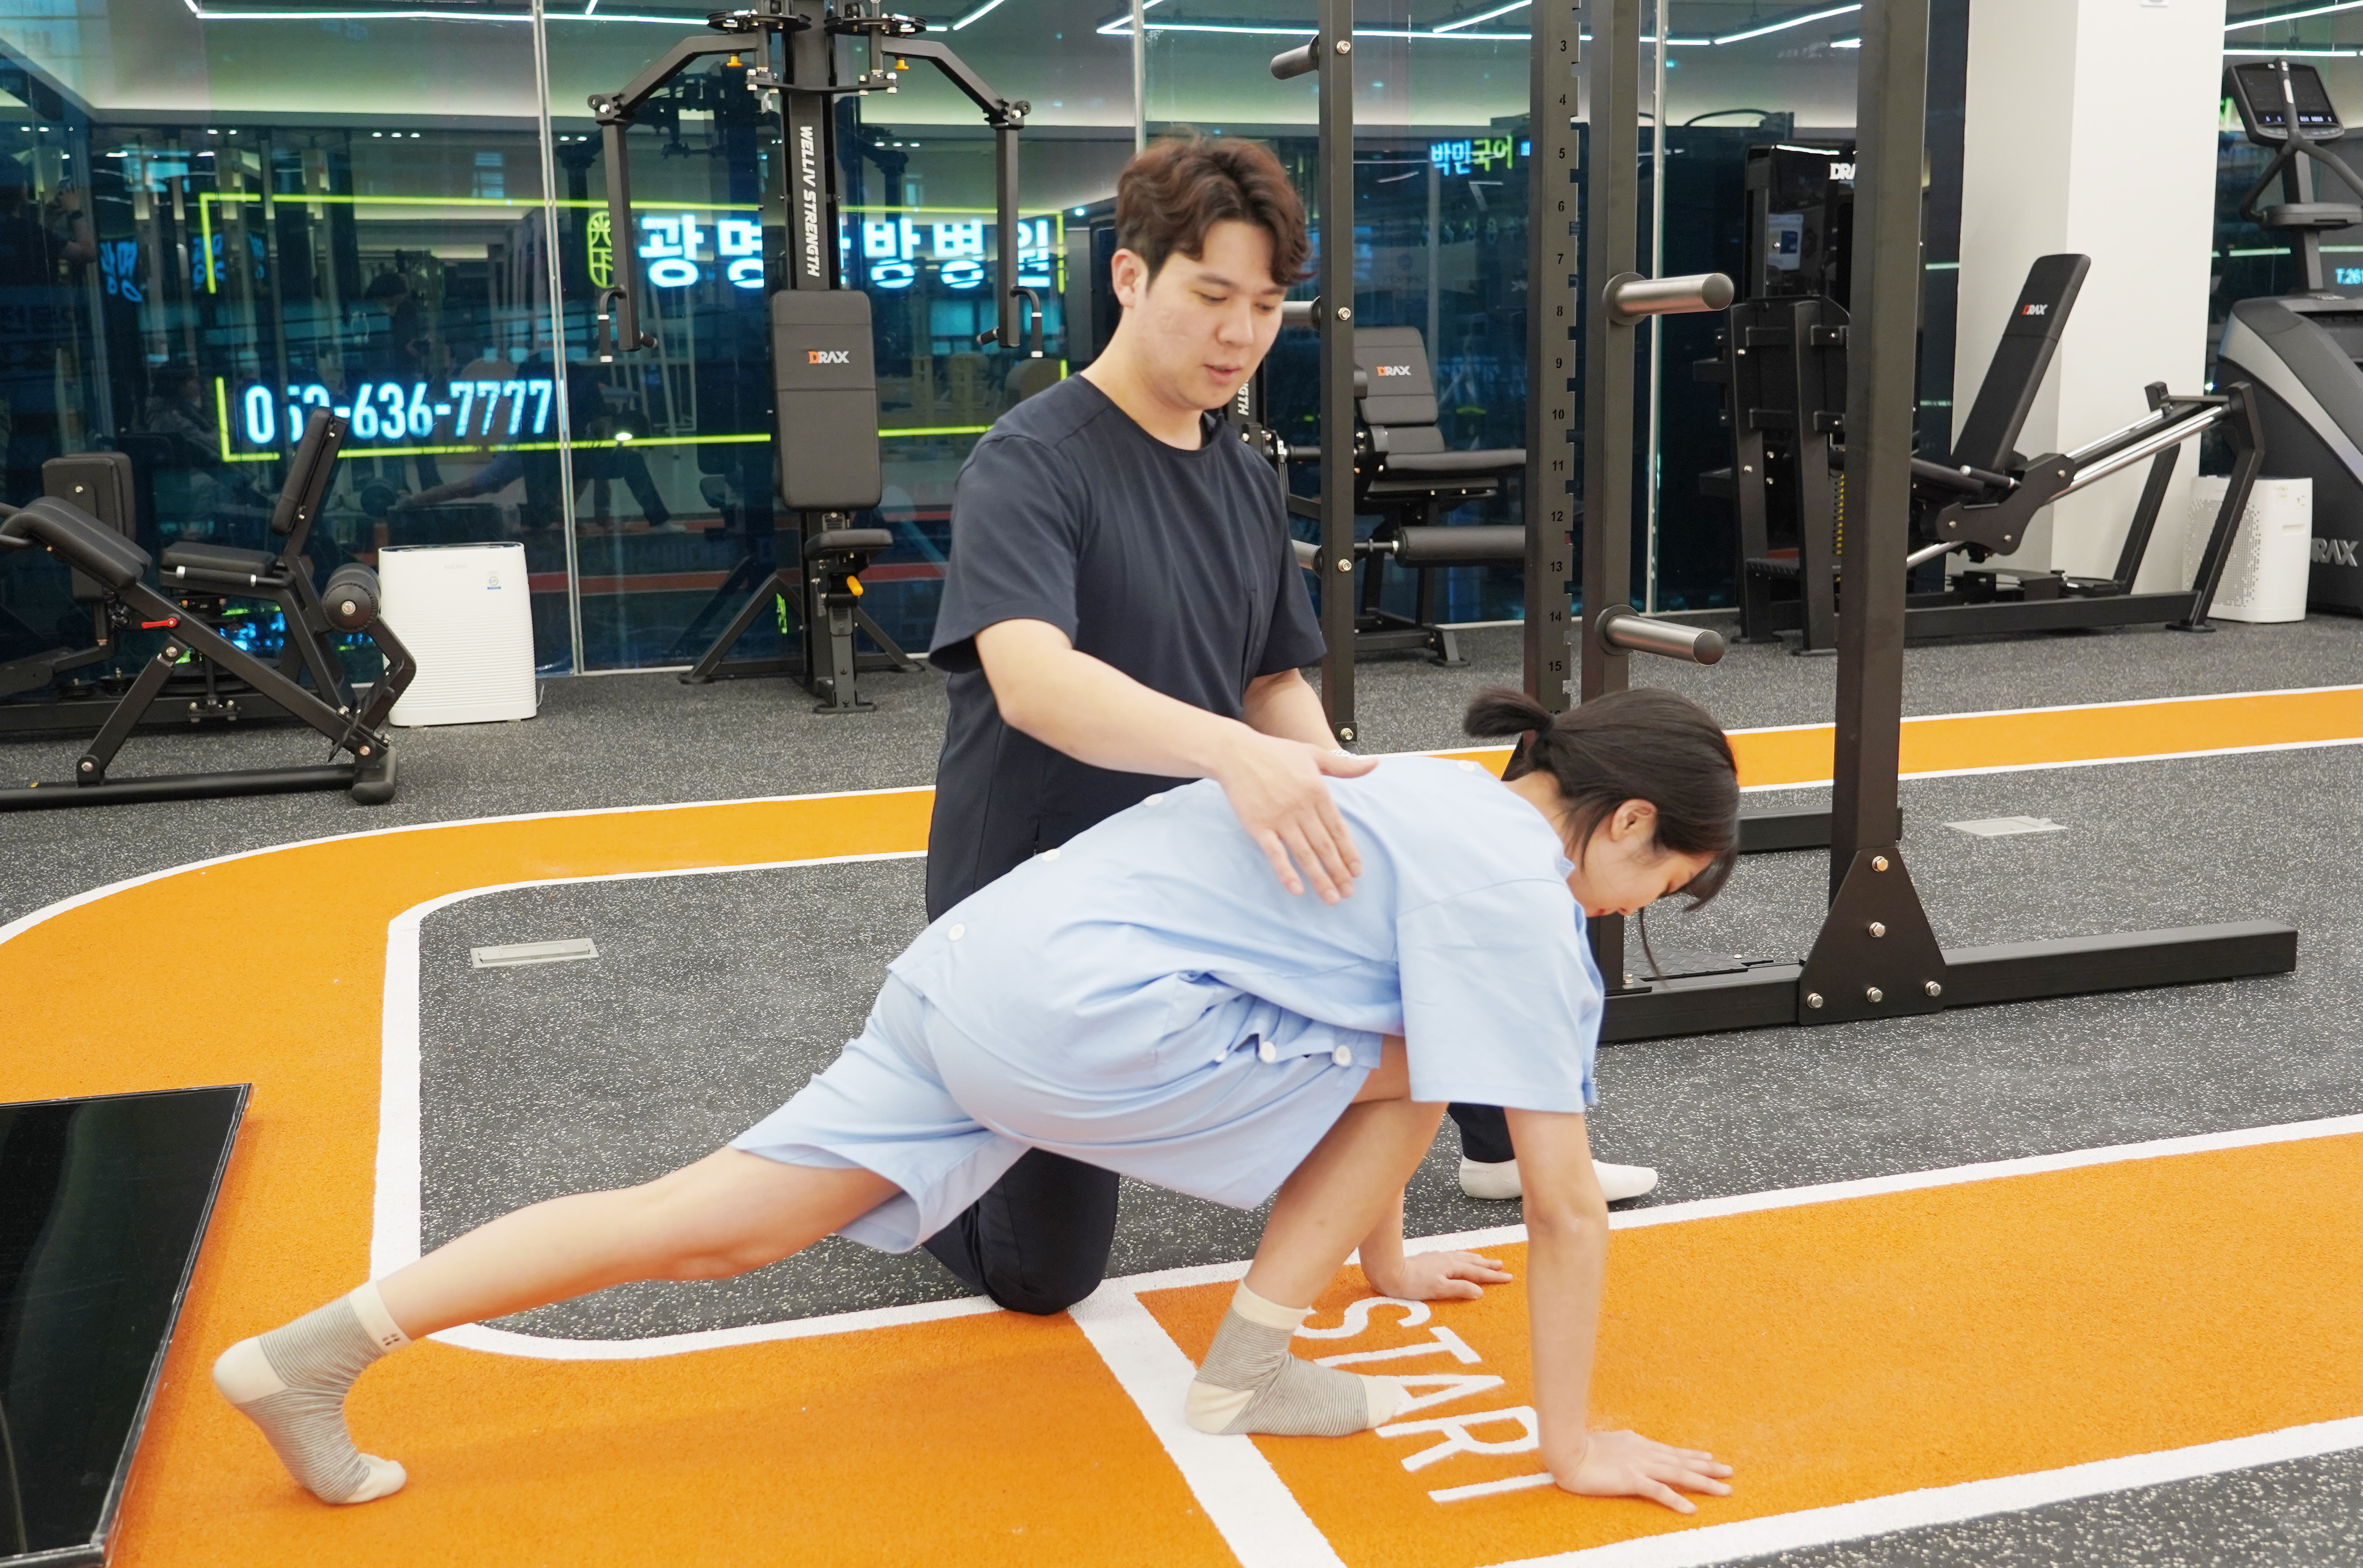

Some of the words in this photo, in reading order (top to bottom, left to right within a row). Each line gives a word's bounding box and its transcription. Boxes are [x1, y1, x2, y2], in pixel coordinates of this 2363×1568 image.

[1560, 40, 1567, 52] 3
[1559, 94, 1566, 105] 4
[800, 126, 816, 187] WELLIV
[1430, 134, 1513, 176] 박민국어
[1559, 148, 1566, 159] 5
[1558, 201, 1565, 212] 6
[803, 189, 820, 277] STRENGTH
[1557, 253, 1564, 264] 7
[1556, 306, 1563, 317] 8
[2021, 304, 2048, 315] DRAX
[808, 351, 850, 364] DRAX
[1556, 358, 1562, 369] 9
[1376, 366, 1411, 376] DRAX
[1552, 409, 1565, 420] 10
[1552, 460, 1563, 471] 11
[1551, 510, 1563, 522] 12
[1550, 561, 1562, 572] 13
[1549, 611, 1562, 622] 14
[1548, 660, 1562, 672] 15
